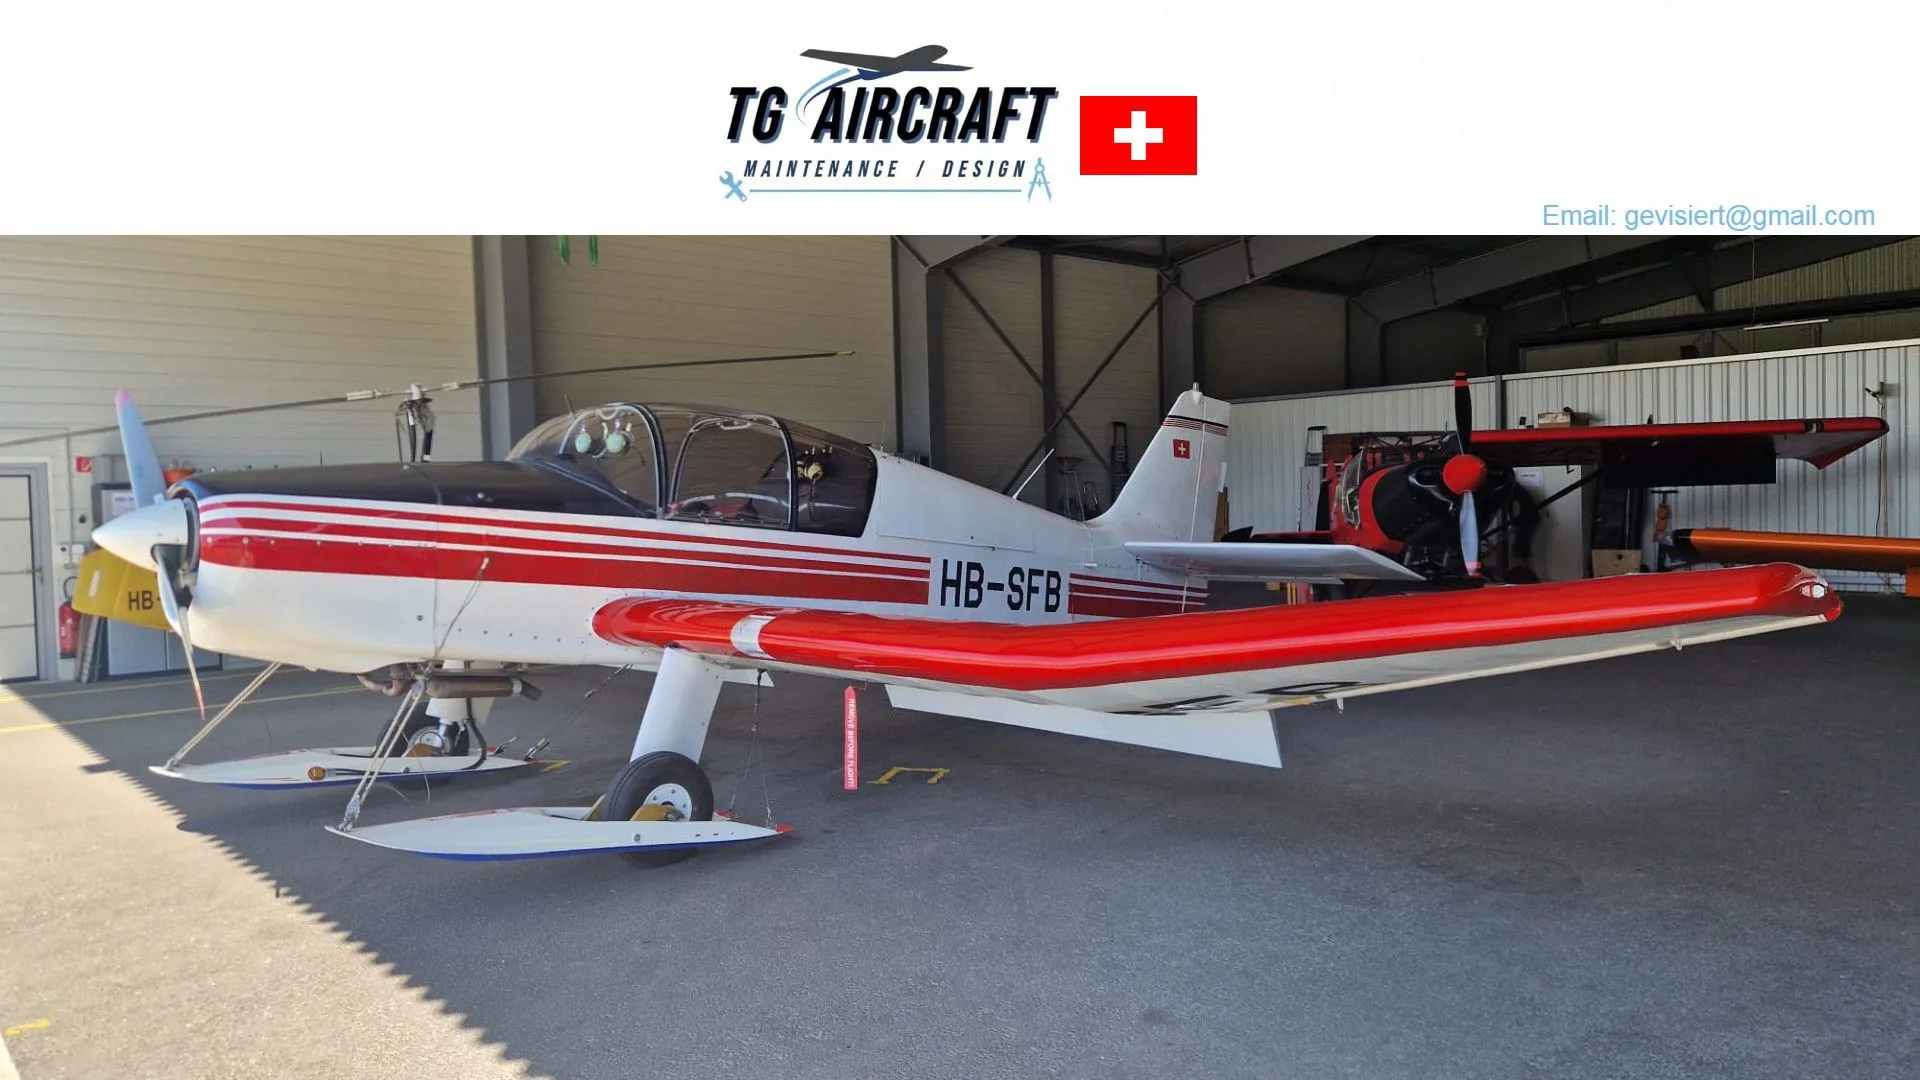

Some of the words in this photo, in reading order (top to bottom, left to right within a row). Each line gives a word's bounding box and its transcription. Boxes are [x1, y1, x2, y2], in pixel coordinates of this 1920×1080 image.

[940, 559, 1061, 612] HB-SFB
[847, 698, 856, 729] REMOVE
[847, 730, 856, 759] BEFORE
